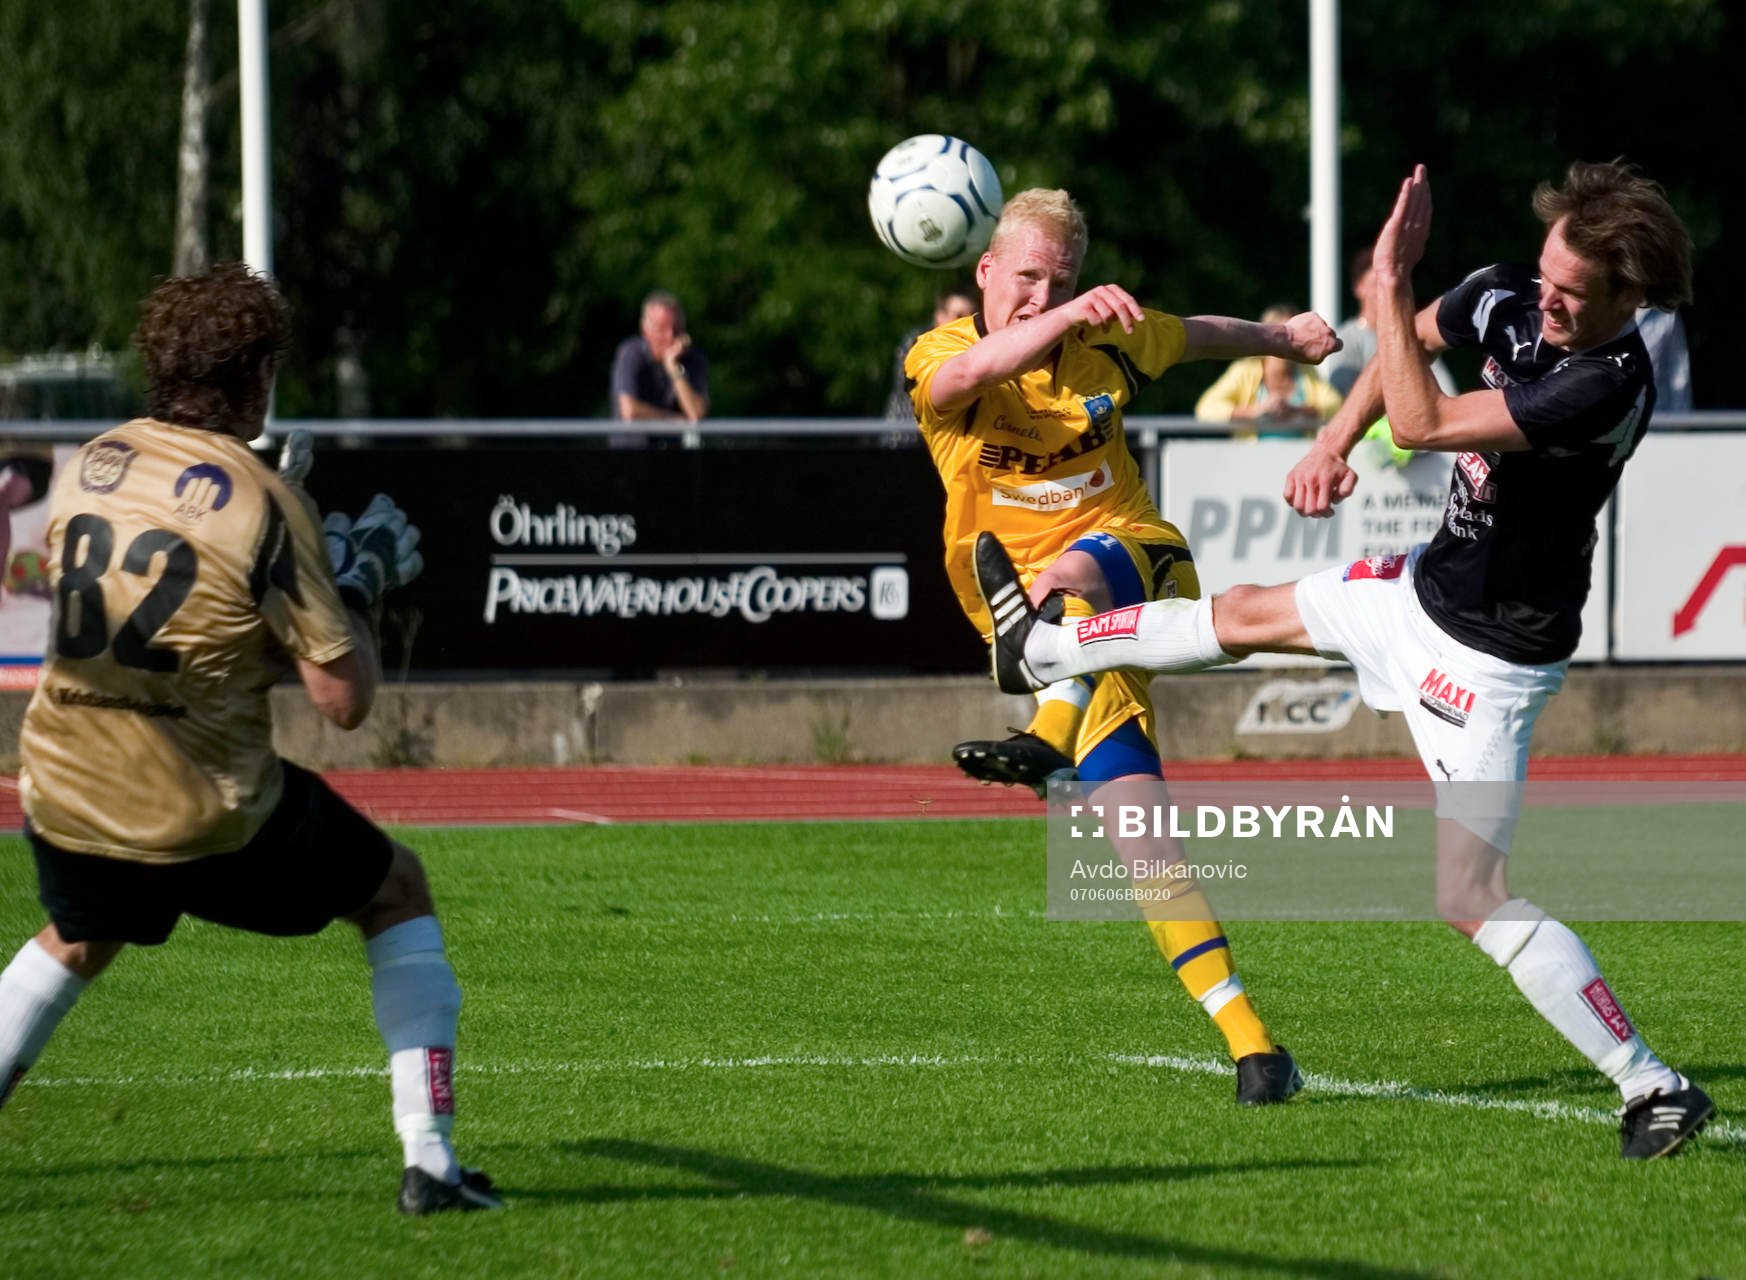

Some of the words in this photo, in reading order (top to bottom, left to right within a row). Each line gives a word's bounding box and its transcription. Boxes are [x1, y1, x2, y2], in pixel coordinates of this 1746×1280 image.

[997, 426, 1106, 475] PEAB
[1458, 451, 1489, 488] EAM
[490, 494, 637, 557] Öhrlings
[1191, 498, 1347, 561] PPM
[56, 512, 197, 673] 82
[1419, 667, 1477, 713] MAXI
